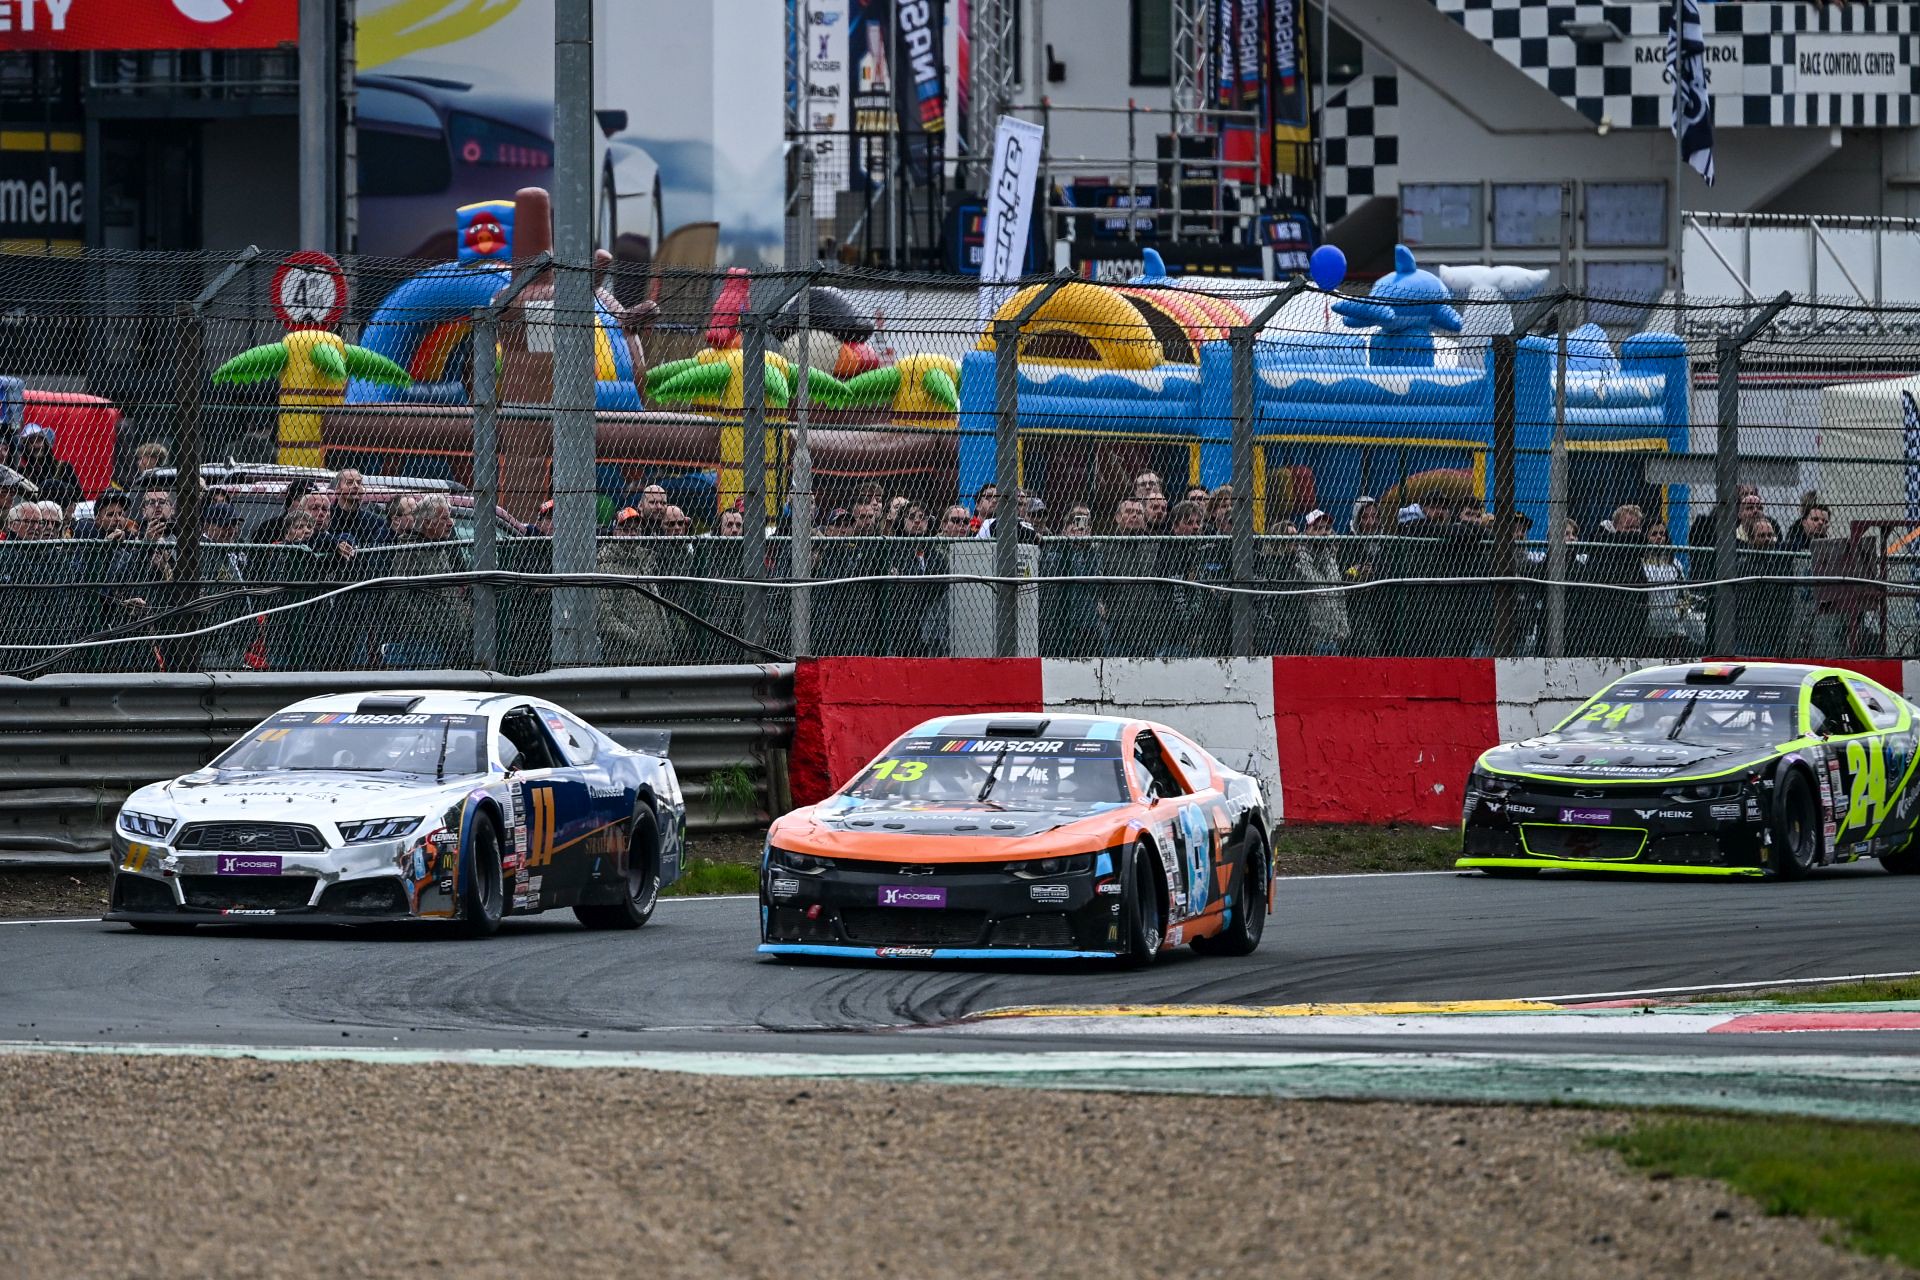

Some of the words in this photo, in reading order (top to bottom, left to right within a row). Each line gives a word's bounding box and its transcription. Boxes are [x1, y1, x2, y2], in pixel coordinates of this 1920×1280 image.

[1800, 53, 1821, 76] RACE
[1823, 52, 1862, 76] CONTROL
[1864, 53, 1895, 76] CENTER
[1668, 689, 1750, 700] NASCAR
[1581, 703, 1633, 722] 24
[339, 714, 431, 724] NASCAR
[969, 741, 1064, 753] NASCAR
[872, 759, 928, 781] 13
[1846, 736, 1886, 829] 24
[1506, 804, 1536, 814] HEINZ
[1658, 811, 1694, 819] HEINZ
[531, 787, 555, 867] 11
[430, 834, 459, 842] KENNOL
[124, 843, 149, 872] 11
[236, 861, 277, 869] HOOSIER
[898, 893, 941, 901] HOOSIER
[880, 946, 934, 955] KENNOL
